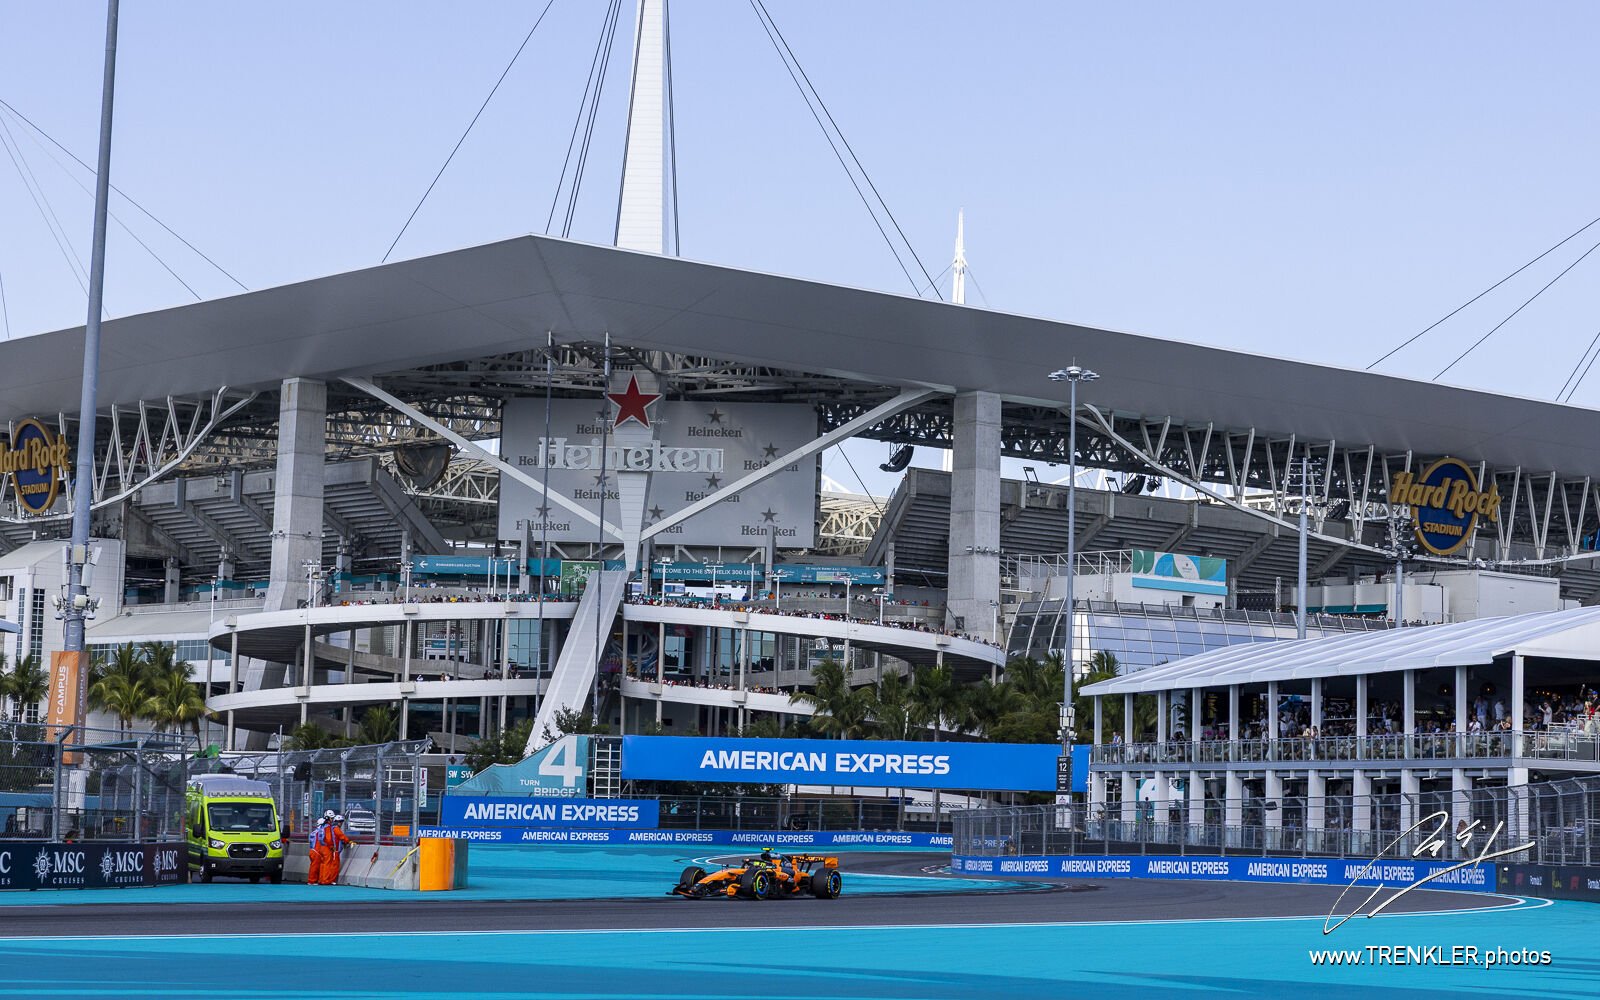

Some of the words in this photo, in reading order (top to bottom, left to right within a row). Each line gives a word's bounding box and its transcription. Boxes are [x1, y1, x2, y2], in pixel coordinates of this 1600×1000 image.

[687, 426, 742, 438] Heineken
[31, 433, 71, 476] Rock
[538, 436, 723, 472] Heineken
[21, 483, 49, 495] STADIUM
[574, 489, 620, 500] Heineke
[1391, 472, 1451, 508] Hard
[1446, 479, 1501, 522] Rock
[741, 525, 796, 536] Heinken
[1423, 522, 1462, 536] STADIUM
[57, 666, 66, 714] CAMPUS
[538, 736, 582, 788] 4
[700, 750, 826, 772] AMERICAN
[834, 753, 950, 775] EXPRESS
[1059, 762, 1067, 772] 12
[448, 770, 458, 778] SW
[534, 787, 576, 798] BRIDGE
[464, 802, 556, 820] AMERICAN
[561, 804, 639, 822] EXPRESS
[461, 831, 502, 840] EXPRESS
[522, 831, 566, 841] AMERICAN
[570, 832, 610, 842] EXPRESS
[628, 832, 672, 842] AMERICAN
[675, 832, 713, 842] EXPRESS
[732, 833, 774, 842] AMERICAN
[776, 834, 814, 843] EXPRESS
[832, 834, 873, 843] AMERICAN
[876, 834, 912, 844] EXPRESS
[53, 852, 85, 873] MSC
[116, 851, 144, 872] MSC
[162, 850, 178, 870] MSC
[1000, 860, 1024, 872] AMERICAN
[1024, 860, 1048, 872] EXPRESS
[1061, 860, 1096, 872] AMERICAN
[1097, 860, 1131, 872] EXPRESS
[1148, 860, 1190, 874] AMERICAN
[1191, 862, 1228, 875] EXPRESS
[1248, 862, 1290, 877] AMERICAN
[1292, 864, 1328, 878] EXPRESS
[1344, 865, 1382, 880] AMERICAN
[1384, 867, 1414, 882] EXPRESS
[1461, 868, 1485, 884] EXPRESS
